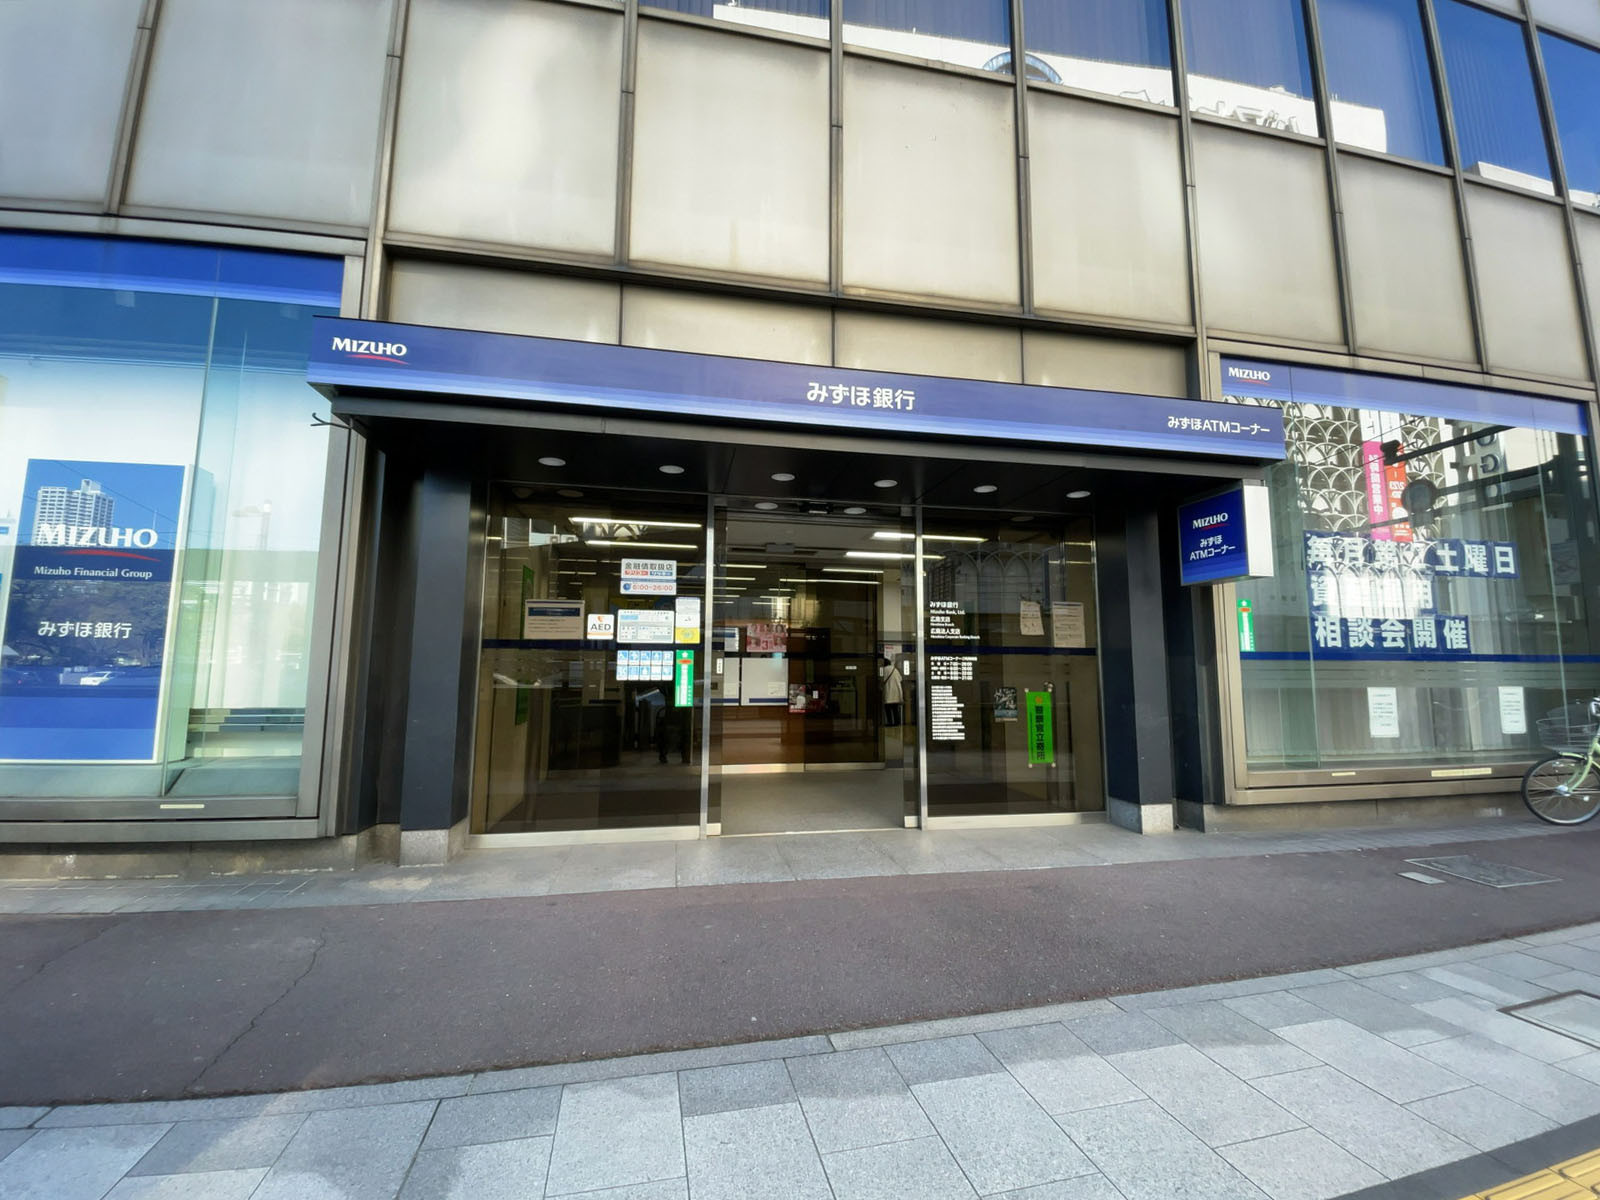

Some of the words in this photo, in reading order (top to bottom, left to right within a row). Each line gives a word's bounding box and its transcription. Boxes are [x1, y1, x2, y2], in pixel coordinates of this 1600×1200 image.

[331, 336, 408, 357] MIZUHO
[1228, 367, 1271, 381] MIZUHO
[806, 381, 916, 411] みずほ銀行
[1167, 415, 1271, 436] みずほATMコーナー
[1192, 512, 1229, 529] MIZUHO
[38, 523, 158, 549] MIZUHO
[1199, 534, 1223, 549] みずほ
[1189, 544, 1237, 561] ATMコーナー
[1307, 535, 1516, 574] 毎月第土曜日
[34, 566, 72, 577] Mizuho
[74, 567, 119, 578] Financial
[121, 568, 153, 580] Group
[37, 620, 132, 640] みずほ銀行
[591, 623, 612, 631] AED
[1314, 616, 1469, 650] 相談会開催
